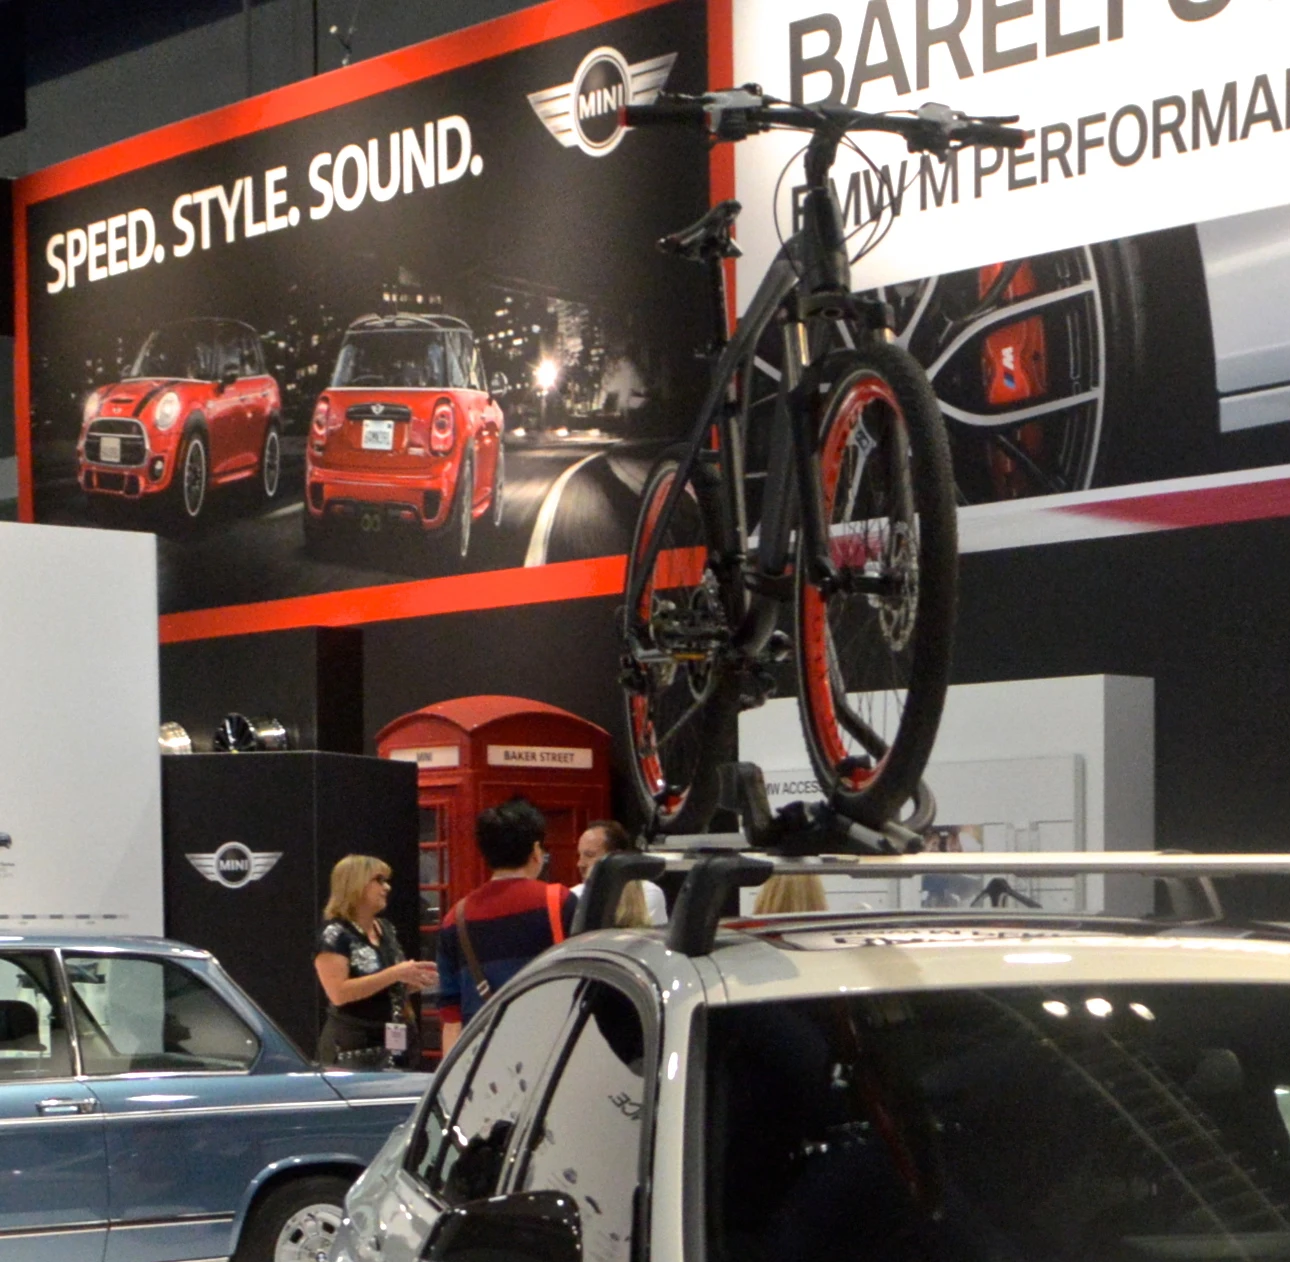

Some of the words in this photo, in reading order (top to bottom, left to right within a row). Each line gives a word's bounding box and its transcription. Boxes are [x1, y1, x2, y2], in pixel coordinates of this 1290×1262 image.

[579, 83, 624, 120] MINI
[919, 150, 959, 212] M
[46, 208, 165, 293] SPEED.
[172, 166, 300, 257] STYLE.
[308, 115, 484, 220] SOUND.
[504, 750, 537, 761] BAKER
[540, 752, 575, 763] STREET
[220, 860, 248, 871] MINI
